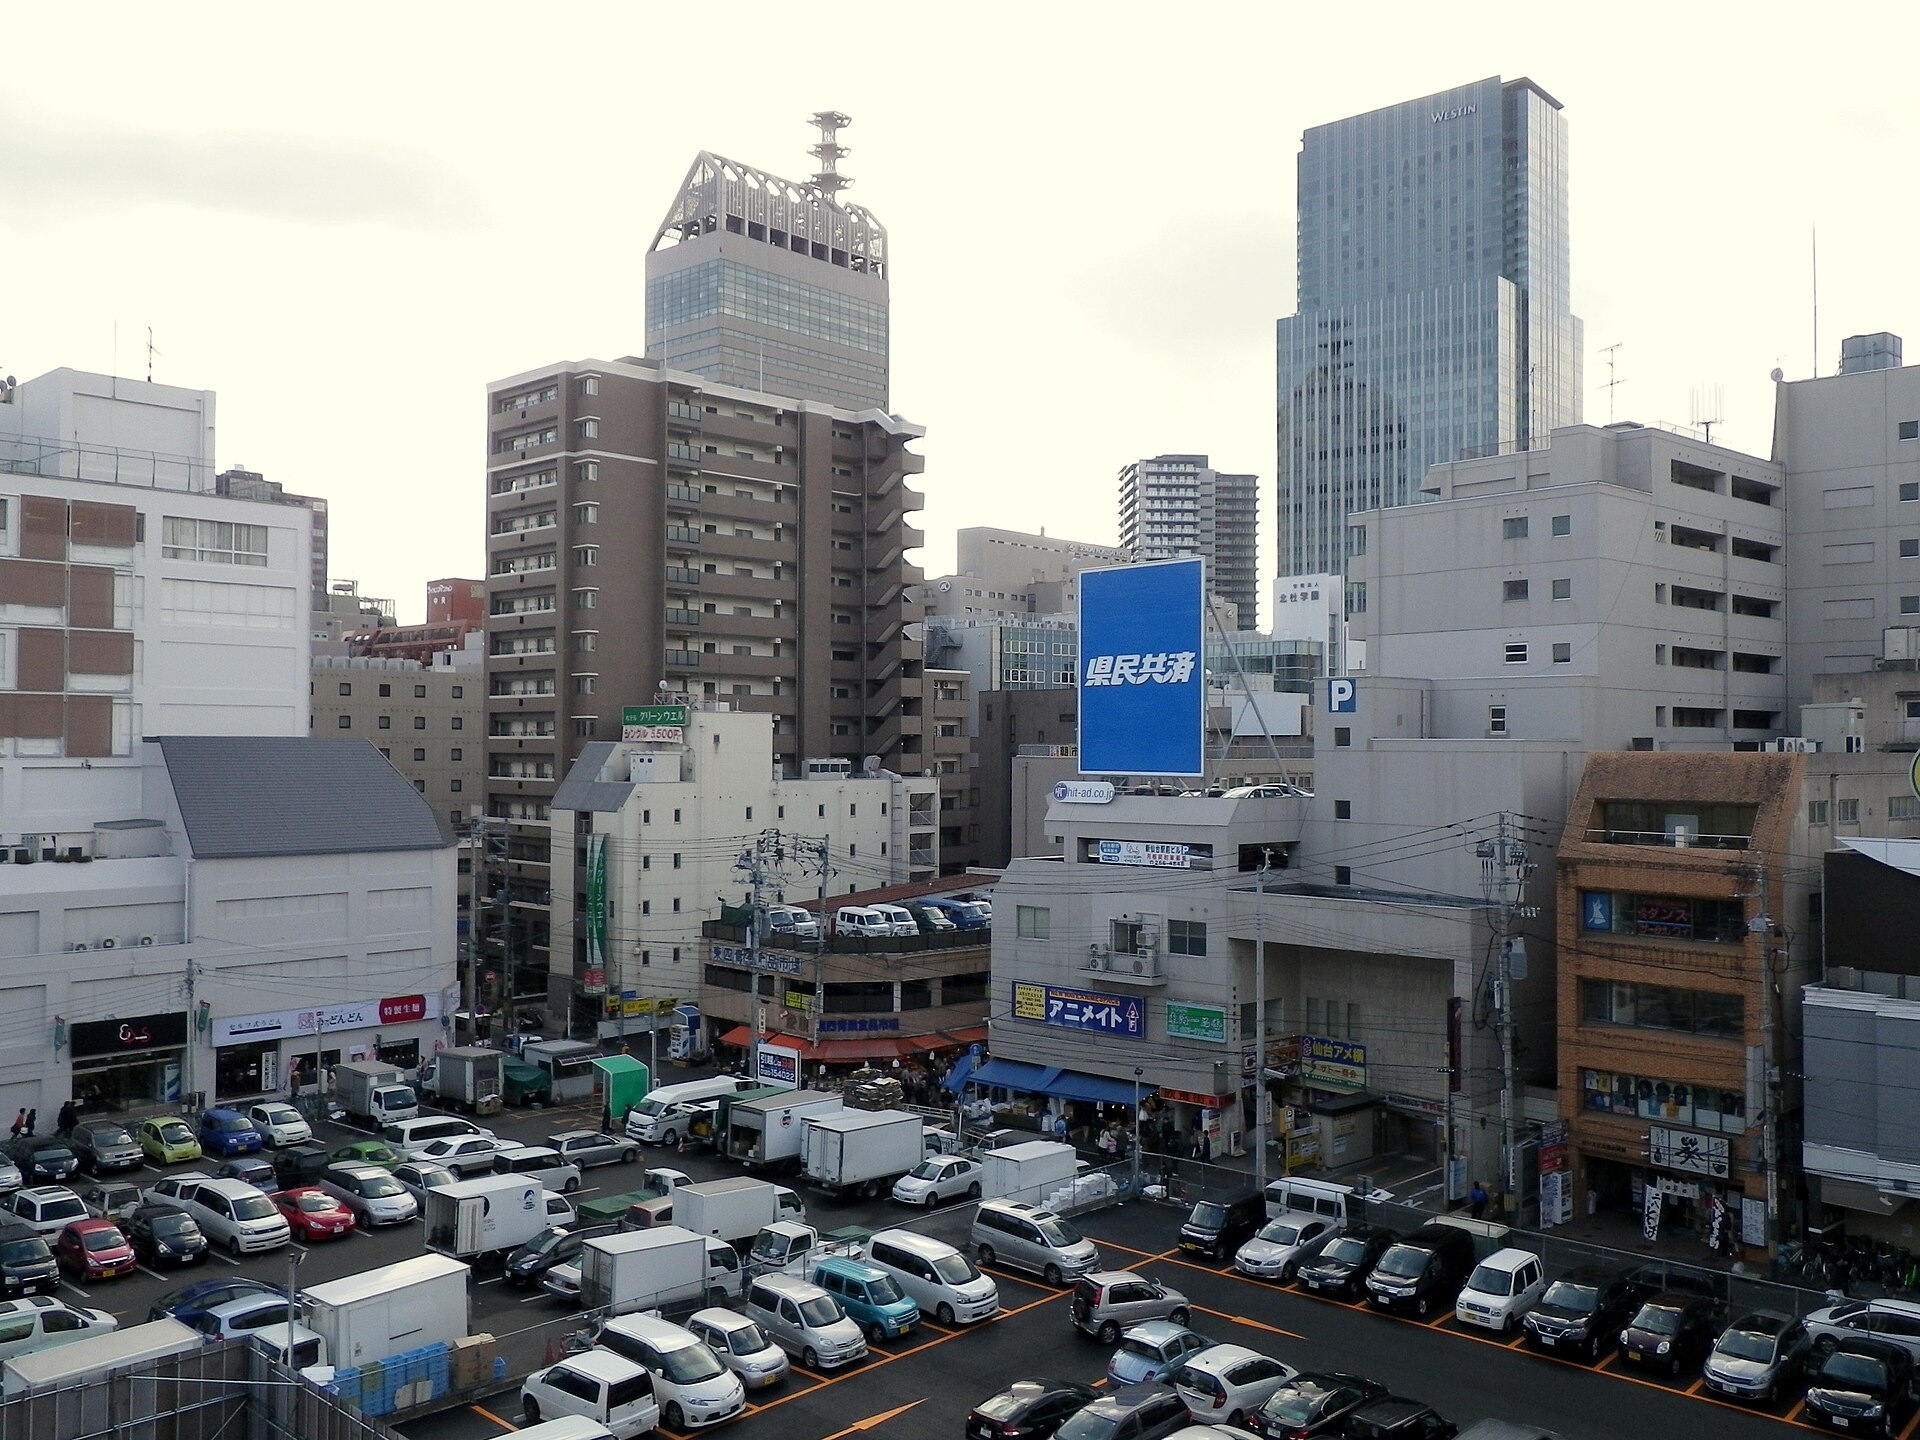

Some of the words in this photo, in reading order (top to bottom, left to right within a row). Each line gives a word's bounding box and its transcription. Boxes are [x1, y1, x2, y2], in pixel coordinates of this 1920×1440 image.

[1431, 103, 1477, 123] WESTIN
[1084, 651, 1196, 687] 県民共済
[1332, 680, 1353, 711] P
[640, 710, 683, 722] グリーンウエル
[624, 728, 649, 739] シングル
[1067, 787, 1114, 800] hit-ad.co.jp
[383, 1002, 421, 1017] 特製生麺
[1049, 999, 1122, 1028] アニメイト
[1312, 1041, 1364, 1064] 仙台アメ横
